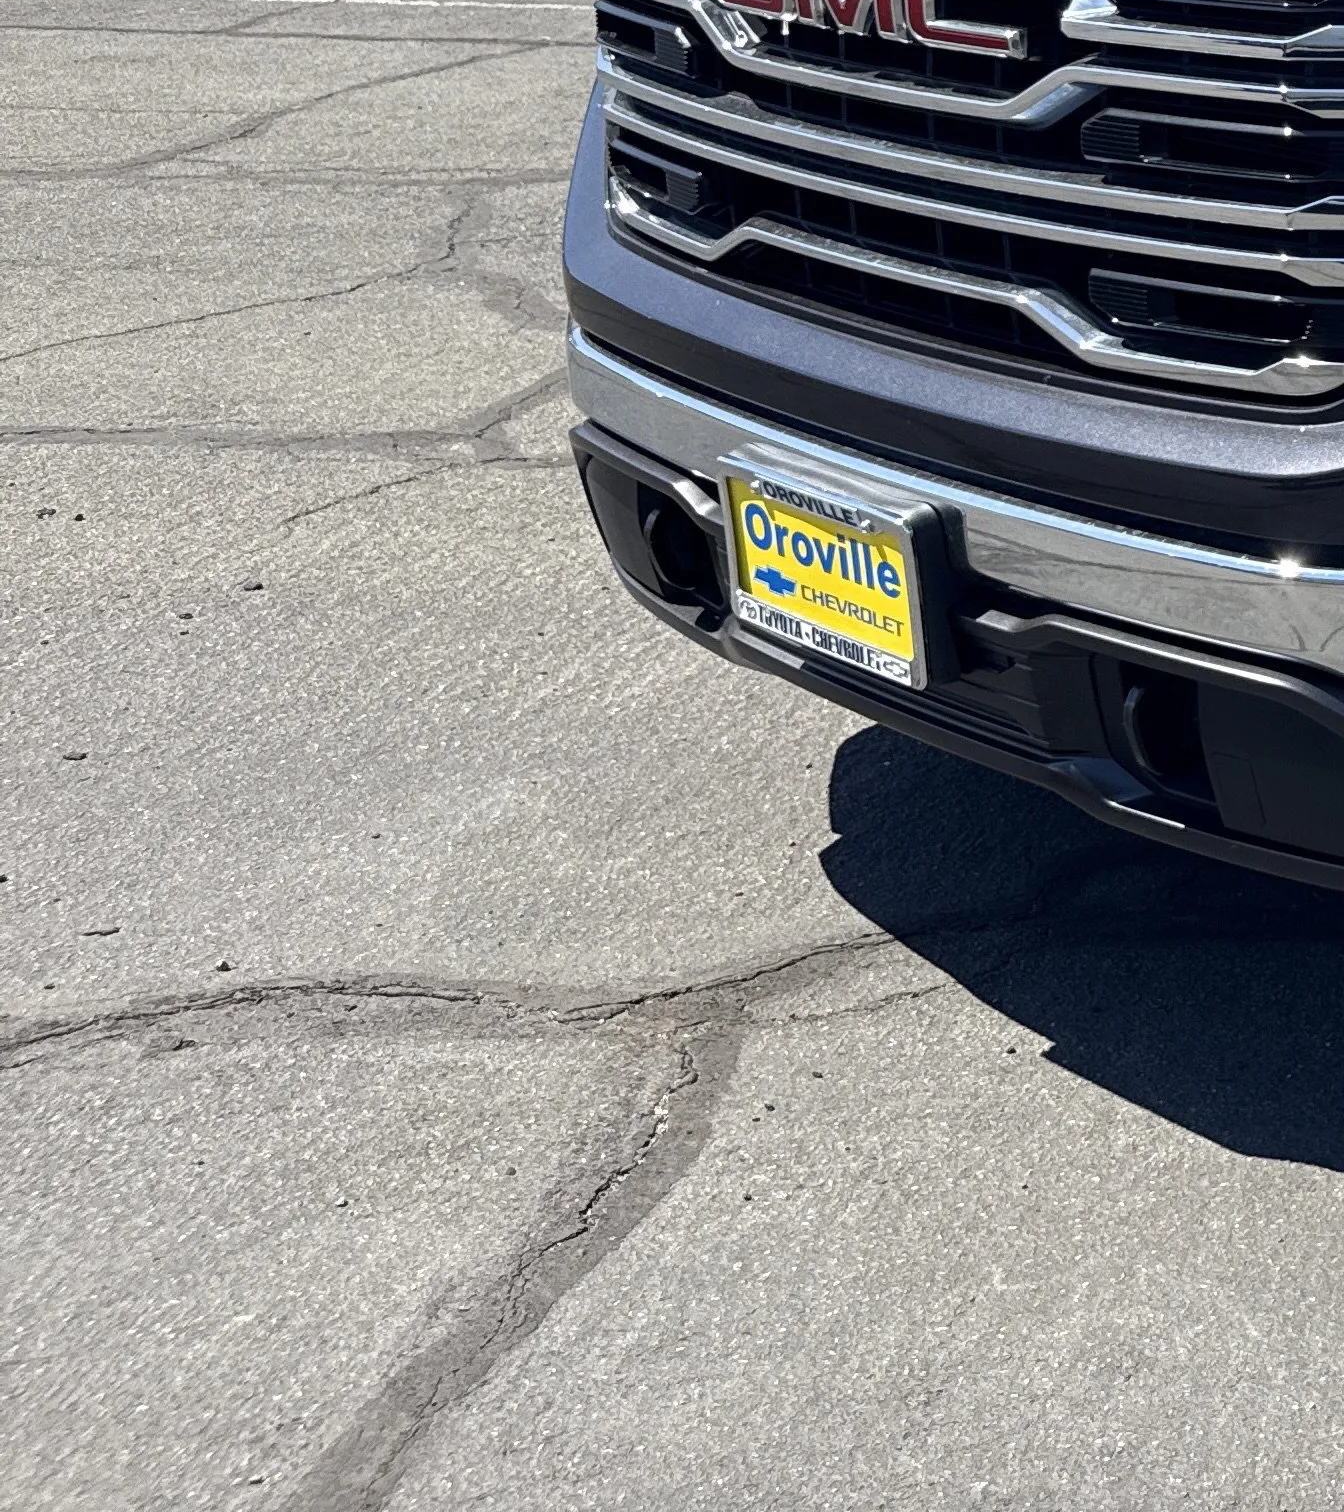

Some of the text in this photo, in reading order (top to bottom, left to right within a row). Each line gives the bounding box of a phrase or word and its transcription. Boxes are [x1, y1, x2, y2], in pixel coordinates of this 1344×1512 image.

[763, 480, 858, 527] OROVILLE
[745, 503, 901, 598] Oroville
[801, 585, 904, 637] CHEVROLET
